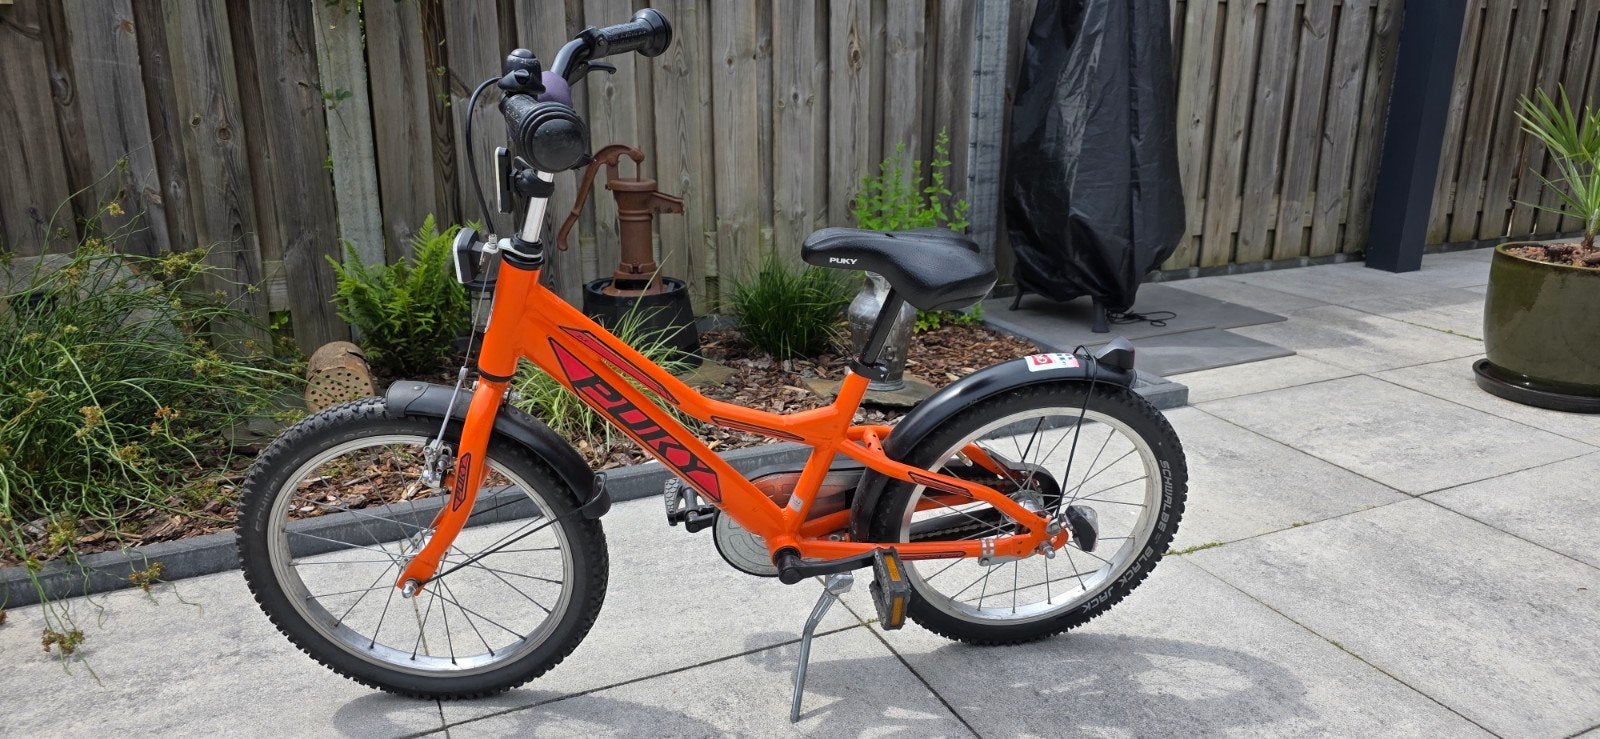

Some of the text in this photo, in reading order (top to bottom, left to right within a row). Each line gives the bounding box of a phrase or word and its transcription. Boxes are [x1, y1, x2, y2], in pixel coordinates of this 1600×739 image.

[829, 257, 857, 265] PUKY
[573, 375, 716, 474] PUKY
[1082, 460, 1174, 613] SCHWALBE BLACK JACK
